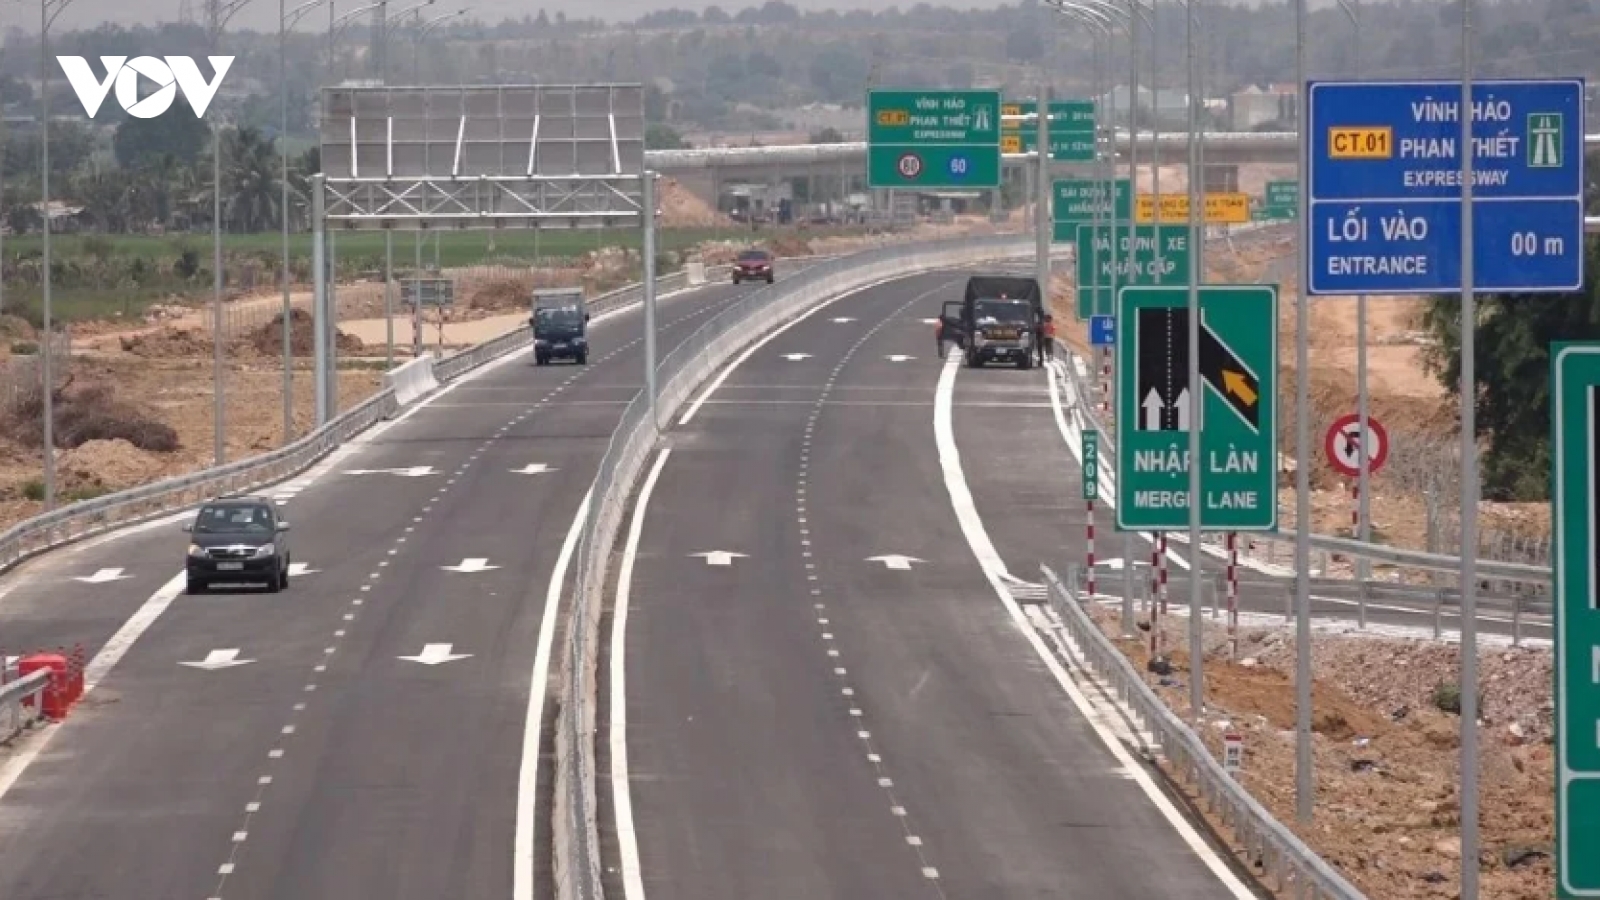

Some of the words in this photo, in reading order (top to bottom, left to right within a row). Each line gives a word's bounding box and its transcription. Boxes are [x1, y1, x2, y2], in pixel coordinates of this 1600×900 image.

[915, 96, 938, 109] VĨNH
[1411, 96, 1459, 122] VĨNH
[1471, 94, 1511, 122] HẢO
[909, 114, 938, 126] PHAN
[1333, 132, 1386, 152] CT.01
[1400, 138, 1455, 158] PHAN
[951, 158, 966, 173] 60
[1328, 206, 1367, 242] LỐI
[1381, 209, 1428, 241] VÀO
[1168, 237, 1186, 250] XE
[1511, 232, 1537, 256] 00
[1545, 237, 1564, 256] m
[1328, 256, 1427, 275] ENTRANCE
[1210, 443, 1258, 473] LÀN
[1208, 491, 1258, 509] LANE
